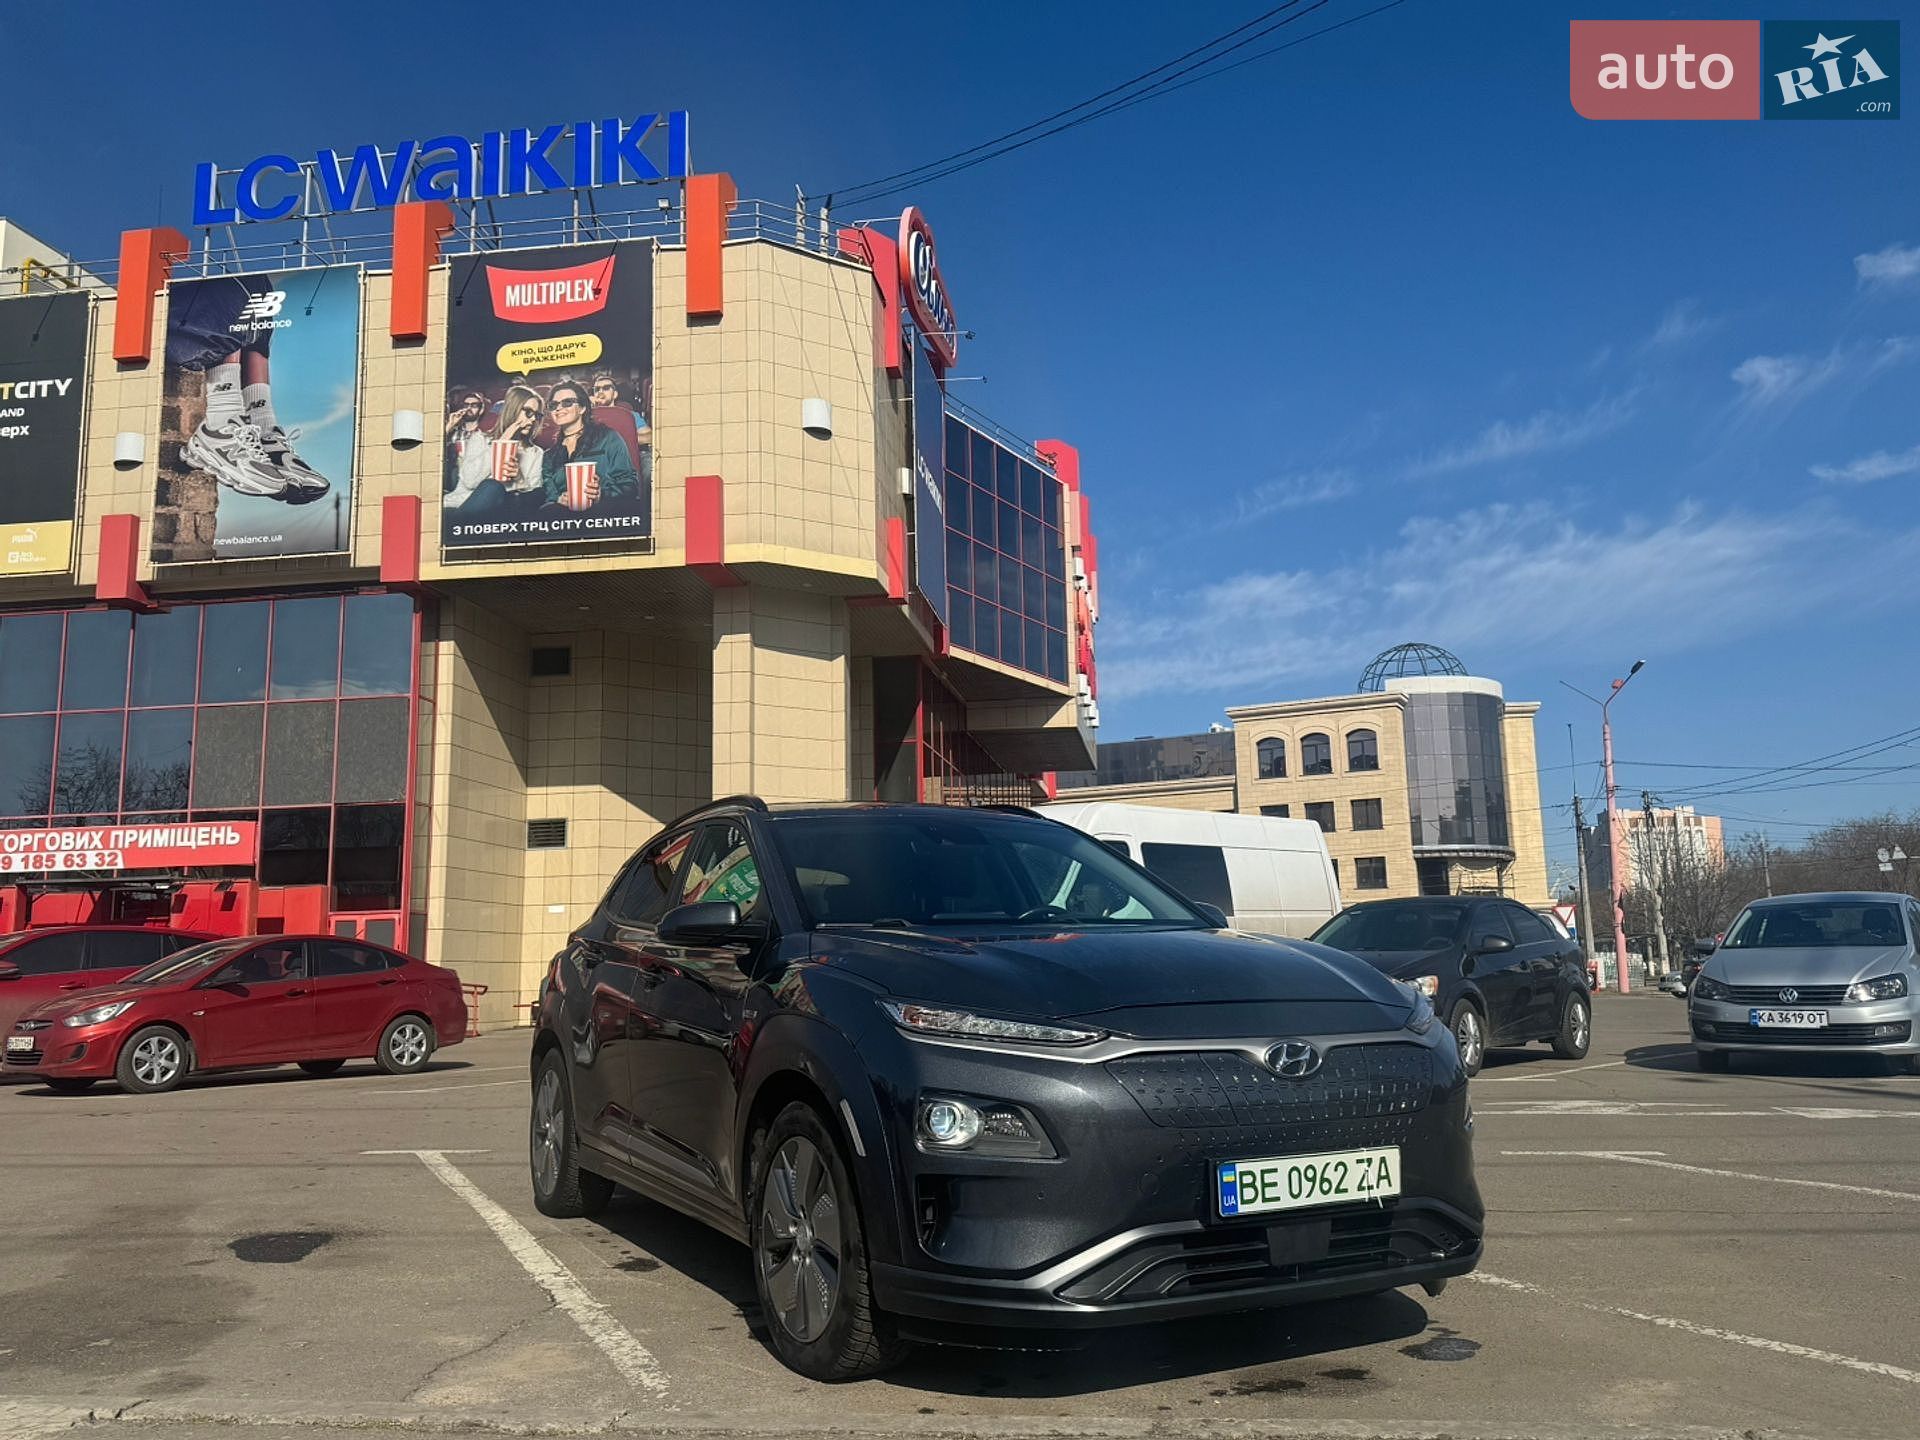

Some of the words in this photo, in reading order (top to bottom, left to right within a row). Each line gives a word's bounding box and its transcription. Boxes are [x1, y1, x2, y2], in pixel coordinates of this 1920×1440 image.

[193, 162, 304, 227] LC
[505, 279, 594, 308] MULTIPLEX
[229, 323, 249, 333] new
[251, 319, 292, 331] balance
[538, 345, 553, 354] ЩО
[0, 407, 25, 418] AND
[0, 425, 30, 439] ерх
[464, 522, 518, 535] ПОВЕРХ
[521, 521, 549, 533] ТРЦ
[551, 519, 583, 531] CITY
[585, 516, 641, 528] CENTER
[109, 825, 241, 849] ПРИМІЩЕНЬ
[20, 854, 56, 870] 185
[63, 853, 87, 868] 63
[94, 851, 119, 867] 32
[1759, 1012, 1775, 1023] KA
[1777, 1012, 1804, 1024] 3619
[1807, 1013, 1825, 1024] OT
[1239, 1168, 1281, 1205] BE
[1288, 1161, 1349, 1200] 0962
[1356, 1156, 1392, 1192] ZA
[1224, 1195, 1236, 1207] UA
